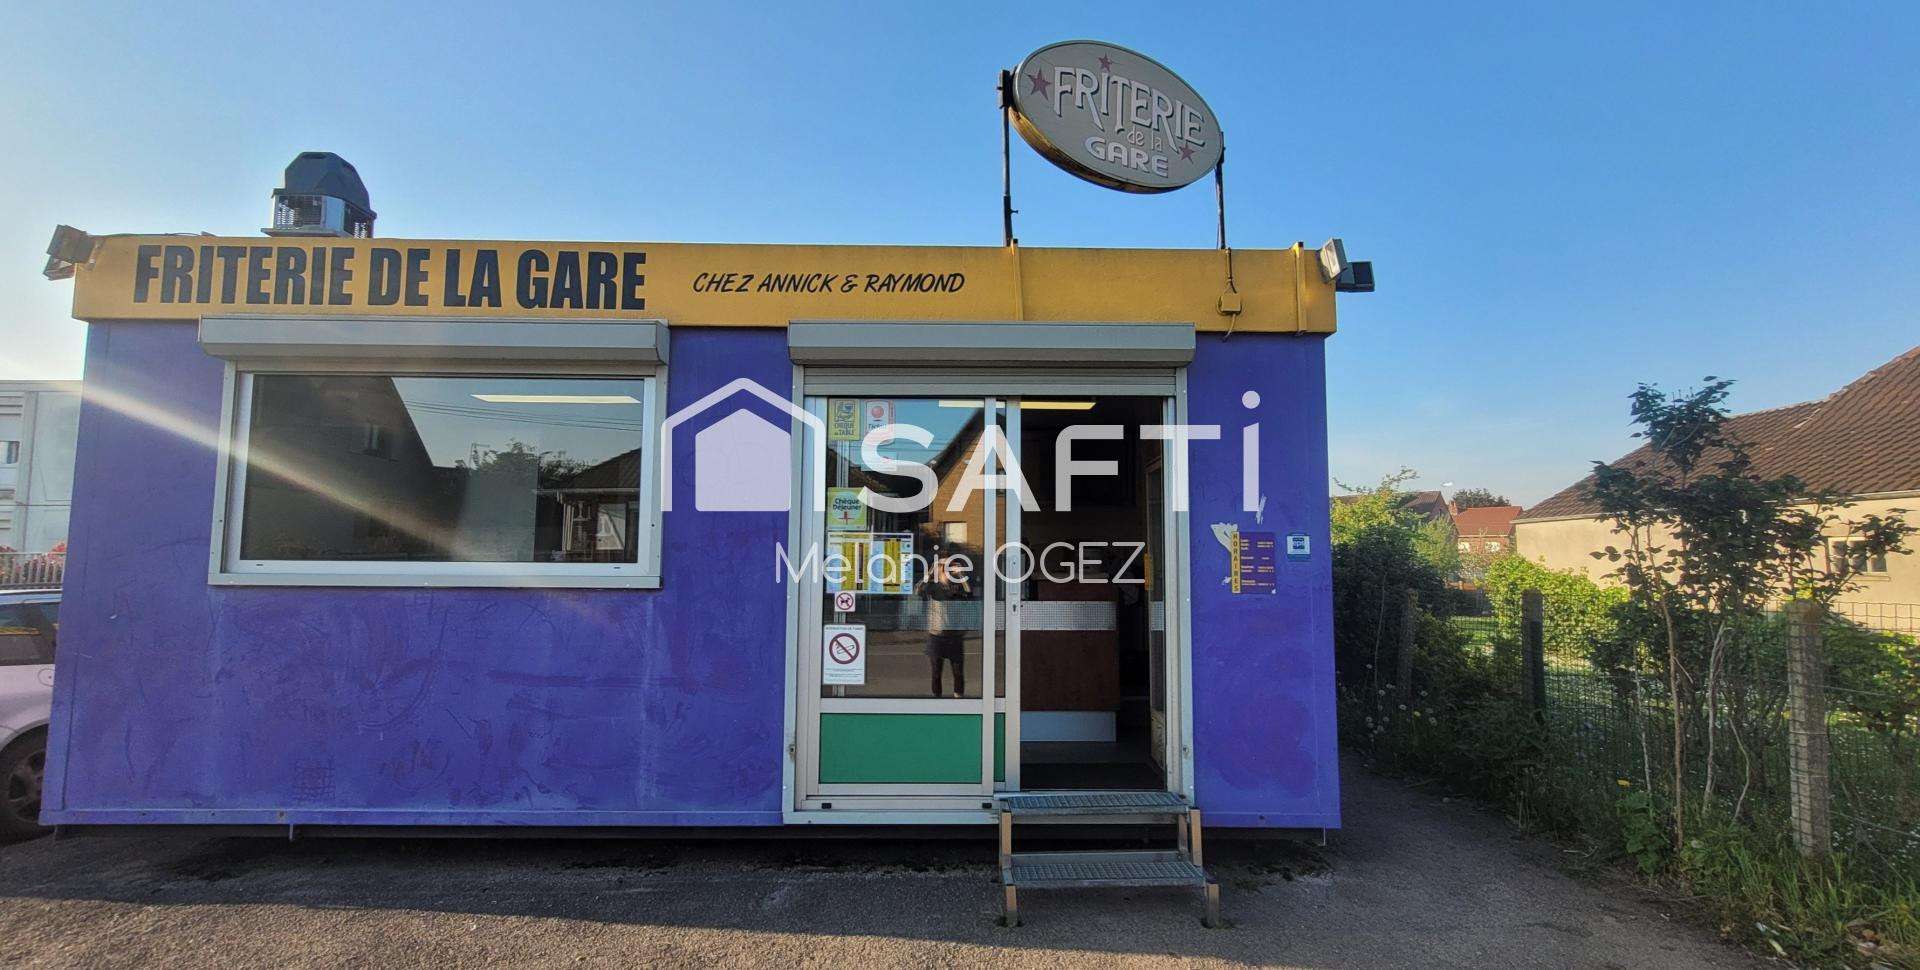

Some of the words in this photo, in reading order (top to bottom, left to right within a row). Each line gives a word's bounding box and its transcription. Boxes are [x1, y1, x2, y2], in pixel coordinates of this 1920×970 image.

[1053, 66, 1206, 155] FRITERIE
[1083, 136, 1169, 179] GARE
[1126, 125, 1145, 147] de
[1151, 131, 1163, 153] la
[133, 244, 355, 306] FRITERIE
[367, 247, 431, 307] DE
[443, 248, 503, 308] LA
[516, 249, 647, 311] GARE
[692, 272, 755, 293] CHEZ
[757, 273, 838, 293] ANNICK
[840, 273, 859, 293] &
[863, 272, 966, 293] RAYMOND
